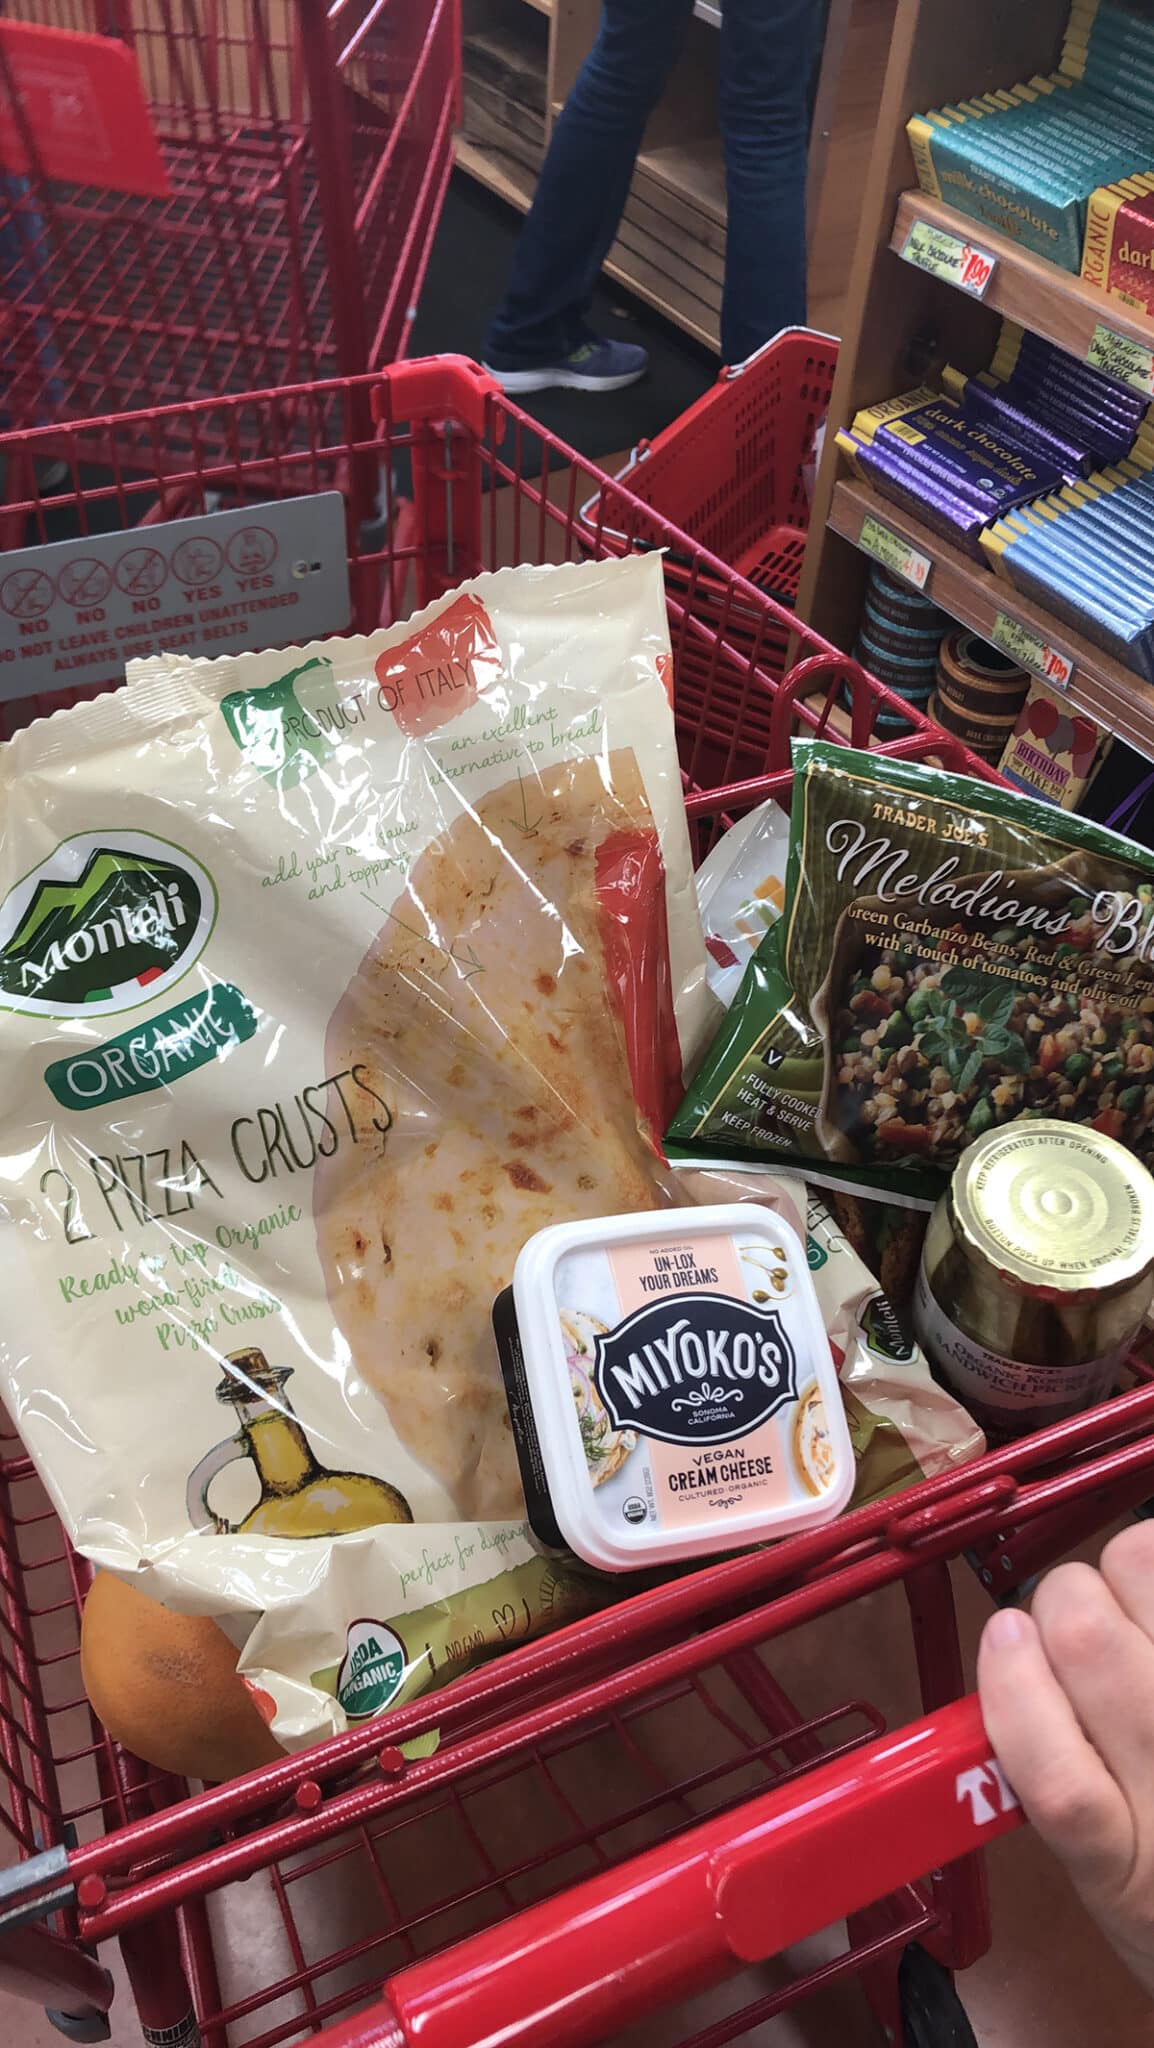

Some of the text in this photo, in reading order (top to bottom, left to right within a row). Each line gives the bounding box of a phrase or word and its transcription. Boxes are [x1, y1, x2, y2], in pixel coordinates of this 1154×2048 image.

[977, 182, 1060, 242] chocolate
[1082, 205, 1112, 288] RGANIC
[867, 384, 939, 420] ORGANIC
[924, 408, 968, 432] dark
[967, 430, 1038, 481] chocolate
[182, 585, 222, 604] YES
[236, 573, 275, 592] YES
[19, 619, 49, 636] NO
[20, 640, 52, 659] NOT
[58, 630, 110, 651] LEAVE
[114, 612, 194, 639] CHILDREN
[199, 591, 298, 622] UNATTENDED
[75, 608, 105, 625] NO
[131, 597, 161, 615] NO
[54, 620, 249, 673] ALWAYS USE SEAT BELTS
[280, 661, 474, 748] PRODUCT OF ITALY
[429, 708, 602, 785] alternative to bread
[451, 704, 558, 751] an excellent
[1017, 742, 1069, 783] BIRTHDAY
[1022, 765, 1049, 790] CAKE
[872, 803, 989, 848] TRADER JOE'S
[262, 850, 340, 888] add your
[308, 864, 345, 900] and
[826, 819, 1072, 936] Melodious
[20, 882, 187, 989] Montali
[848, 901, 889, 926] Green
[893, 912, 969, 945] Garbanzo
[971, 932, 1021, 960] Beans,
[1024, 945, 1058, 971] Red
[1058, 958, 1074, 972] &
[1078, 960, 1122, 984] Green
[865, 931, 1142, 1011] with a touch of tomatoes and olive oil
[66, 1006, 235, 1098] ORGANIC
[736, 1087, 814, 1133] HEAT & SERVE
[744, 1072, 825, 1121] FULLY COOKED
[721, 1110, 793, 1148] KEEP FROZEN
[1038, 1136, 1066, 1147] AFTER
[1068, 1141, 1110, 1165] OPENING
[39, 1064, 393, 1245] 2 PIZZA CRUSTS
[59, 1254, 139, 1303] Ready
[170, 1241, 209, 1267] top
[215, 1204, 302, 1253] Organic
[653, 1252, 697, 1273] UN-LOX
[1041, 1257, 1057, 1267] UP
[1059, 1261, 1088, 1270] WHEN
[1122, 1225, 1142, 1248] SEAL
[638, 1267, 719, 1292] YOUR DREAMS
[156, 1294, 283, 1351] Pizza Crusts
[610, 1318, 784, 1410] MIYOKO'S
[934, 1331, 1027, 1392] SANDWICH
[953, 1341, 1022, 1381] ORGANIC
[687, 1411, 736, 1426] CALIFORNIA
[691, 1405, 729, 1418] SONOMA
[668, 1456, 774, 1492] CREAM CHEESE
[691, 1448, 746, 1467] VEGAN
[678, 1478, 768, 1502] CULTURED ORGANIC
[401, 1549, 454, 1599] perfect
[454, 1535, 475, 1571] for
[349, 1636, 384, 1675] USDA
[342, 1661, 397, 1702] ORGANIC
